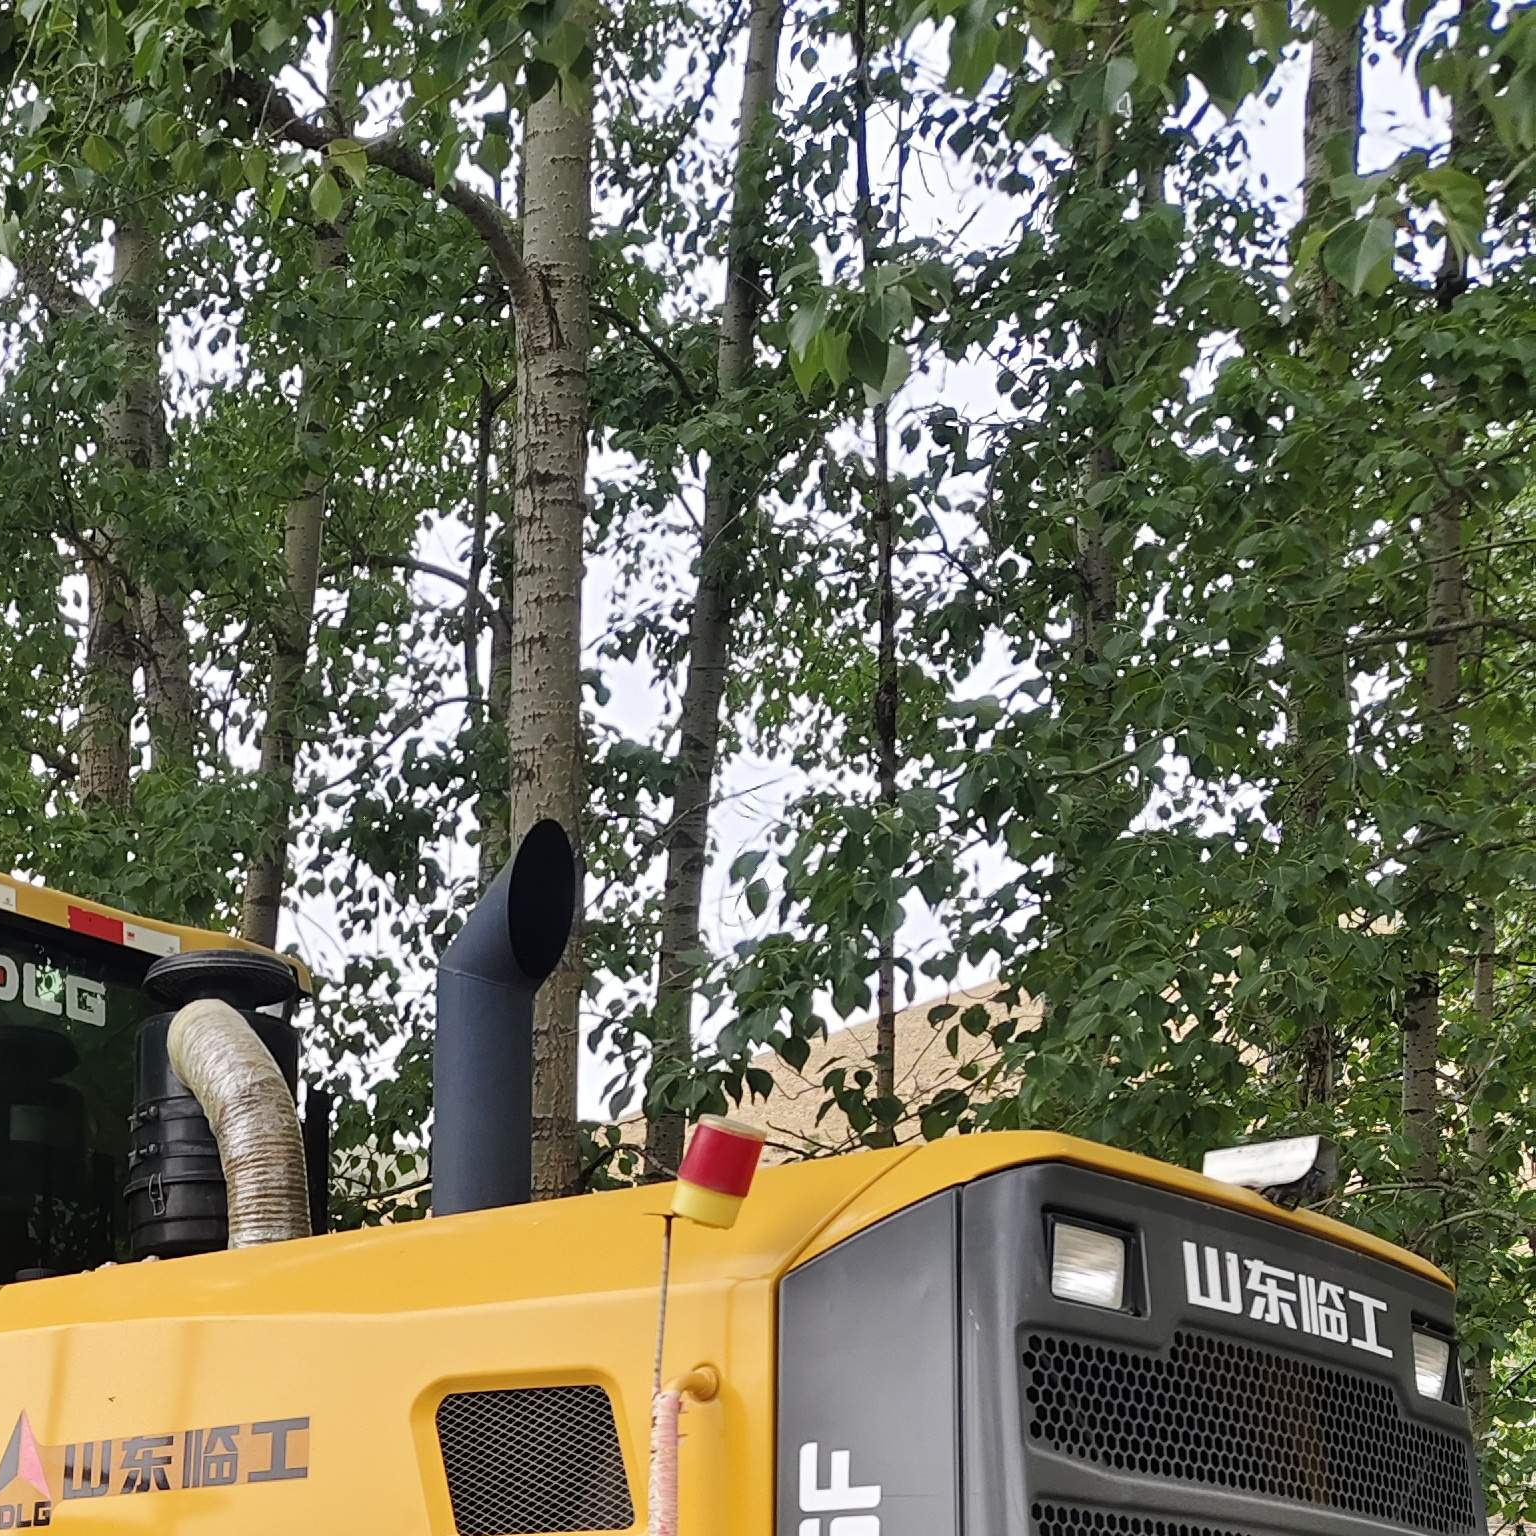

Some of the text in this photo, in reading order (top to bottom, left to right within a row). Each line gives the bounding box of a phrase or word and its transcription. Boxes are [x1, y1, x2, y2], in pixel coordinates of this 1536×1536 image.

[1183, 1240, 1394, 1359] 山东临工
[63, 1416, 310, 1500] 山东临工
